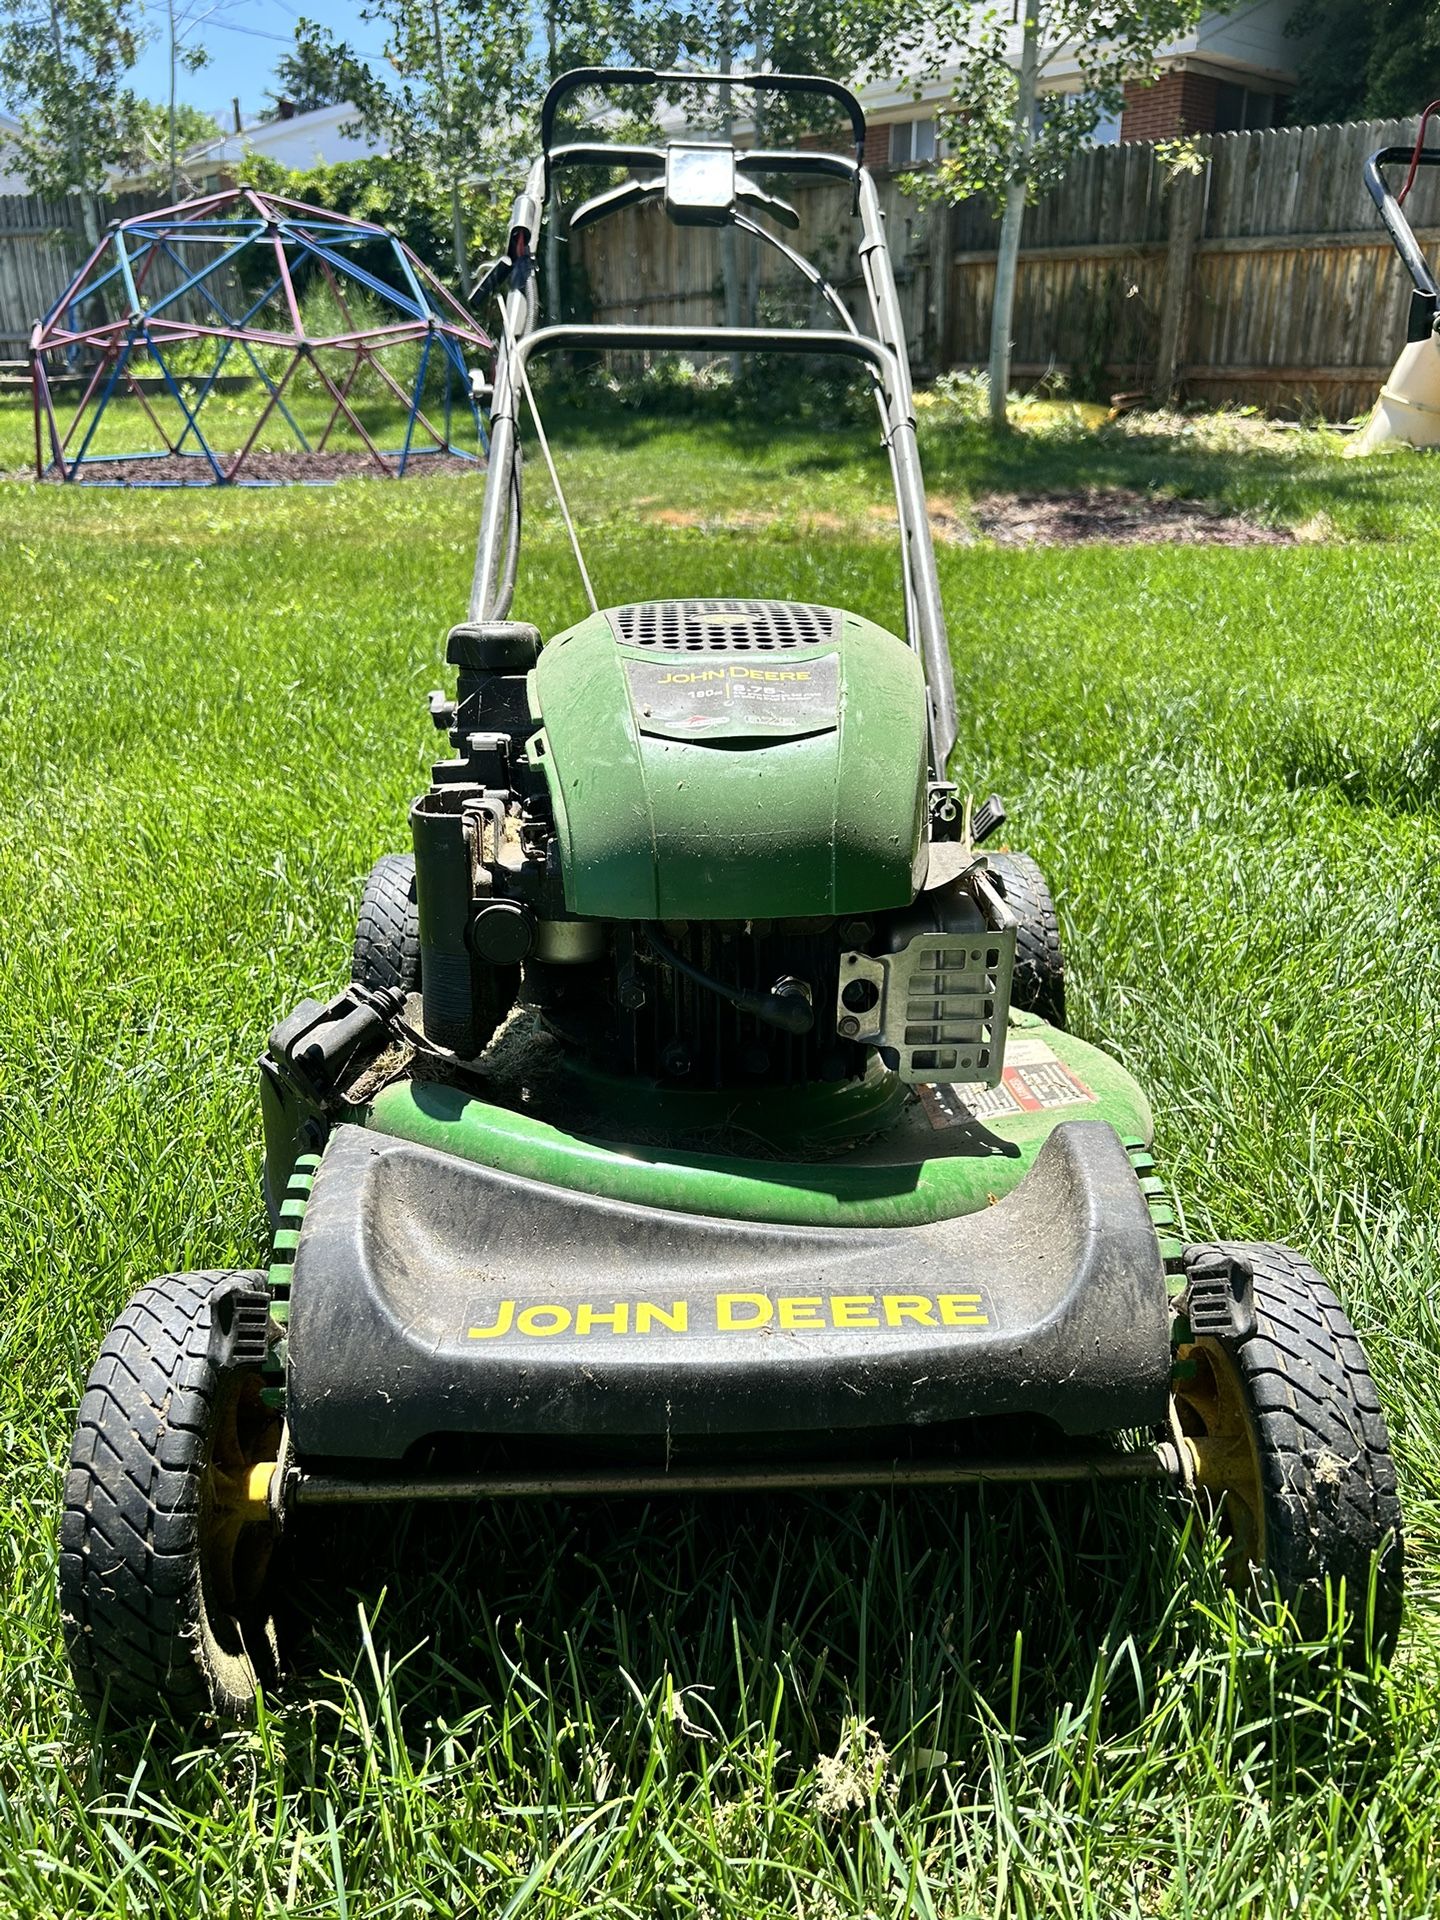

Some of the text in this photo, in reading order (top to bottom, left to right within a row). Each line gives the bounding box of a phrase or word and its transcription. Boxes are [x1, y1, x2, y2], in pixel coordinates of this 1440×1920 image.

[657, 666, 812, 685] JOHN DEERE
[467, 1293, 991, 1339] JOHN DEERE
